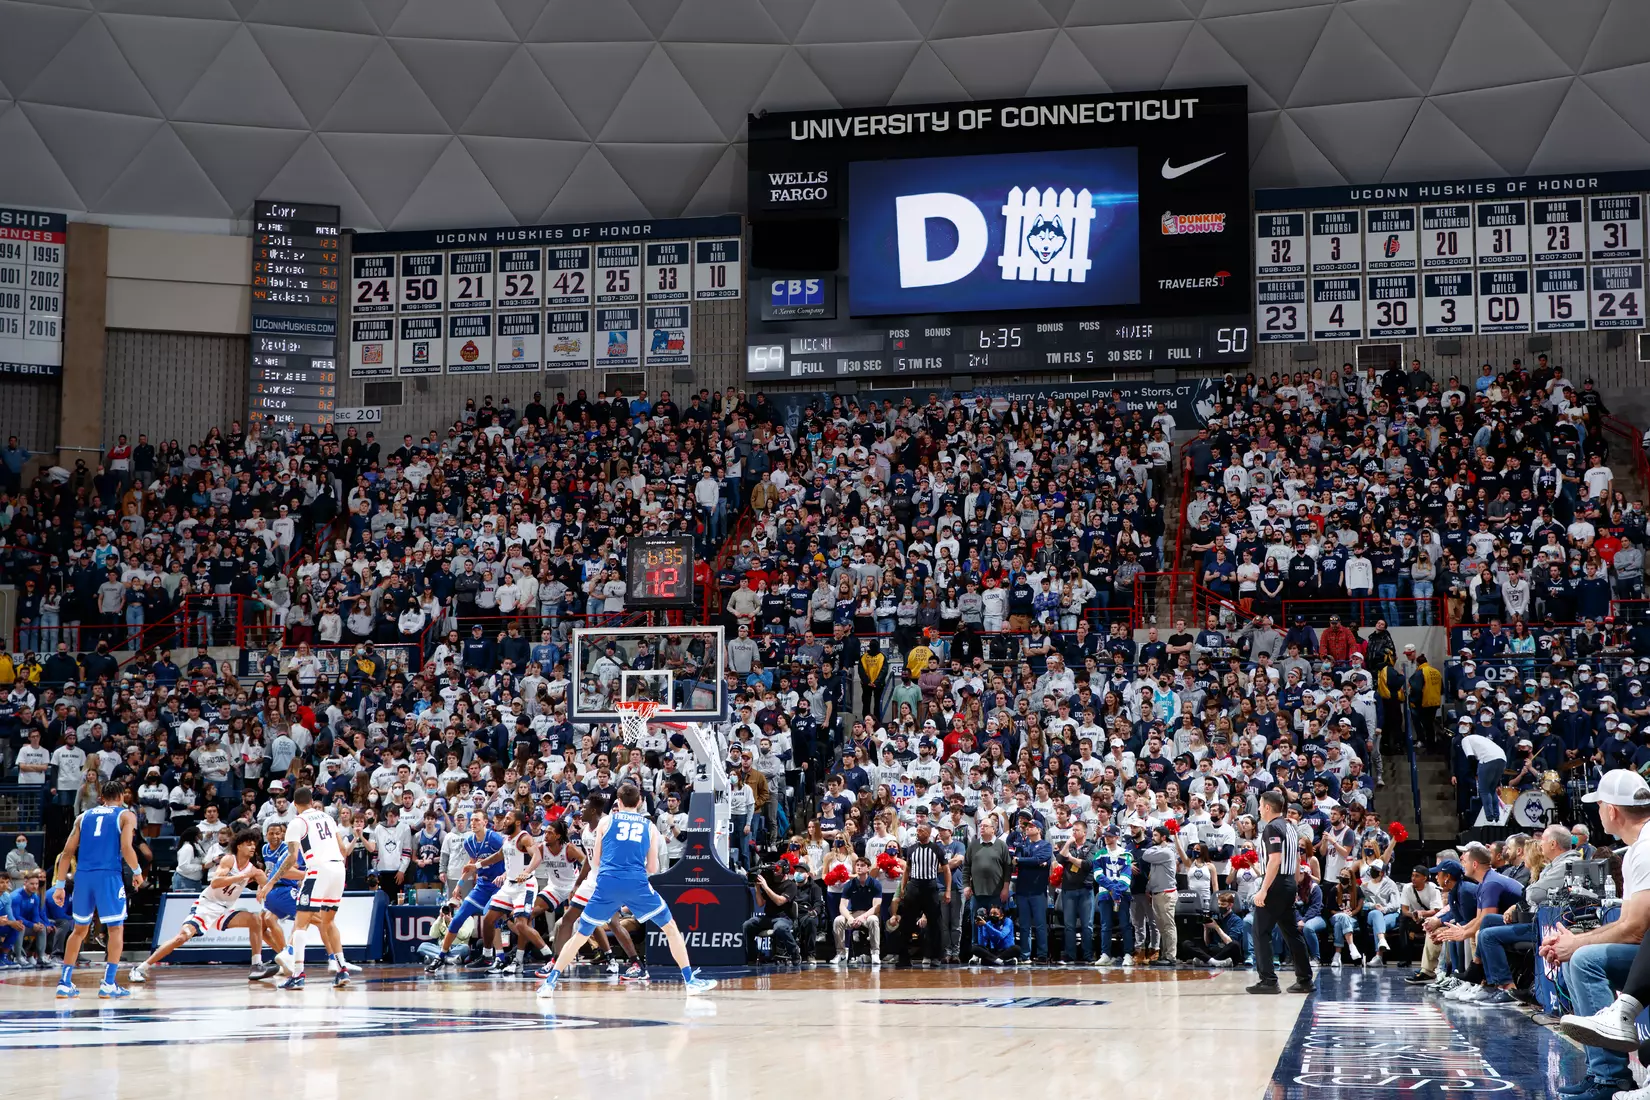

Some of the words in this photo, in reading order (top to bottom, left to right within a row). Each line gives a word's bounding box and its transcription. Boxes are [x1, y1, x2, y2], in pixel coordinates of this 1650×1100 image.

[790, 110, 950, 141] UNIVERSITY
[958, 108, 993, 131] OF
[1000, 98, 1199, 128] CONNECTICUT
[768, 170, 829, 186] WELLS
[770, 186, 828, 202] FARGO
[1350, 188, 1408, 200] UCONN
[1419, 183, 1496, 197] HUSKIES
[1506, 181, 1527, 192] OF
[1538, 178, 1598, 190] HONOR
[1178, 212, 1226, 224] DUNKIN'
[436, 232, 488, 244] UCONN
[496, 228, 563, 241] HUSKIES
[572, 228, 591, 238] OF
[600, 224, 652, 237] HONOR
[1178, 223, 1226, 234] DONUTS
[1546, 225, 1570, 251] 23
[1603, 222, 1627, 248] 31
[896, 191, 989, 289] D
[1330, 236, 1341, 261] 3
[1436, 231, 1458, 256] 20
[1492, 228, 1512, 253] 31
[33, 245, 59, 263] 1995
[1271, 239, 1291, 264] 32
[30, 270, 59, 288] 2002
[504, 273, 535, 297] 52
[552, 271, 585, 295] 42
[606, 269, 630, 293] 25
[658, 267, 677, 291] 33
[709, 265, 726, 289] 10
[1158, 276, 1219, 290] TRAVELERS
[357, 279, 390, 303] 24
[405, 278, 438, 301] 50
[457, 276, 484, 299] 21
[771, 278, 820, 296] CBS
[30, 295, 58, 313] 2009
[779, 307, 796, 315] Xerox
[796, 307, 825, 315] Company
[1440, 299, 1456, 324] 3
[1488, 297, 1520, 323] CD
[1548, 294, 1572, 319] 15
[1598, 291, 1638, 317] 24
[1265, 306, 1297, 331] 23
[1329, 304, 1345, 328] 4
[1376, 301, 1408, 327] 30
[29, 320, 56, 337] 2016
[889, 329, 910, 338] POSS
[924, 328, 951, 337] BONUS
[1037, 323, 1064, 333] BONUS
[1079, 321, 1100, 331] POSS
[978, 328, 1022, 348] 6:35
[1217, 327, 1248, 353] 50
[754, 346, 783, 371] 59
[1046, 352, 1061, 364] TM
[1063, 352, 1081, 363] FLS
[1086, 351, 1094, 364] 5
[1107, 351, 1120, 362] 30
[1122, 350, 1142, 361] SEC
[1167, 348, 1191, 360] FULL
[802, 362, 824, 373] FULL
[849, 361, 861, 372] 30
[863, 360, 882, 371] SEC
[898, 359, 905, 371] 5
[908, 359, 923, 370] TM
[925, 358, 942, 368] FLS
[1050, 390, 1089, 400] Gampel
[1141, 387, 1174, 397] Storrs,
[1176, 386, 1190, 395] CT
[356, 409, 381, 420] 201
[1126, 402, 1144, 411] the
[1145, 401, 1177, 410] Wrld
[648, 548, 683, 565] 6:35
[654, 567, 678, 598] 12
[93, 815, 104, 837] 1
[316, 822, 332, 841] 24
[615, 821, 644, 842] 32
[553, 869, 560, 879] 5
[221, 884, 236, 897] 44
[647, 931, 744, 948] TRVELERS
